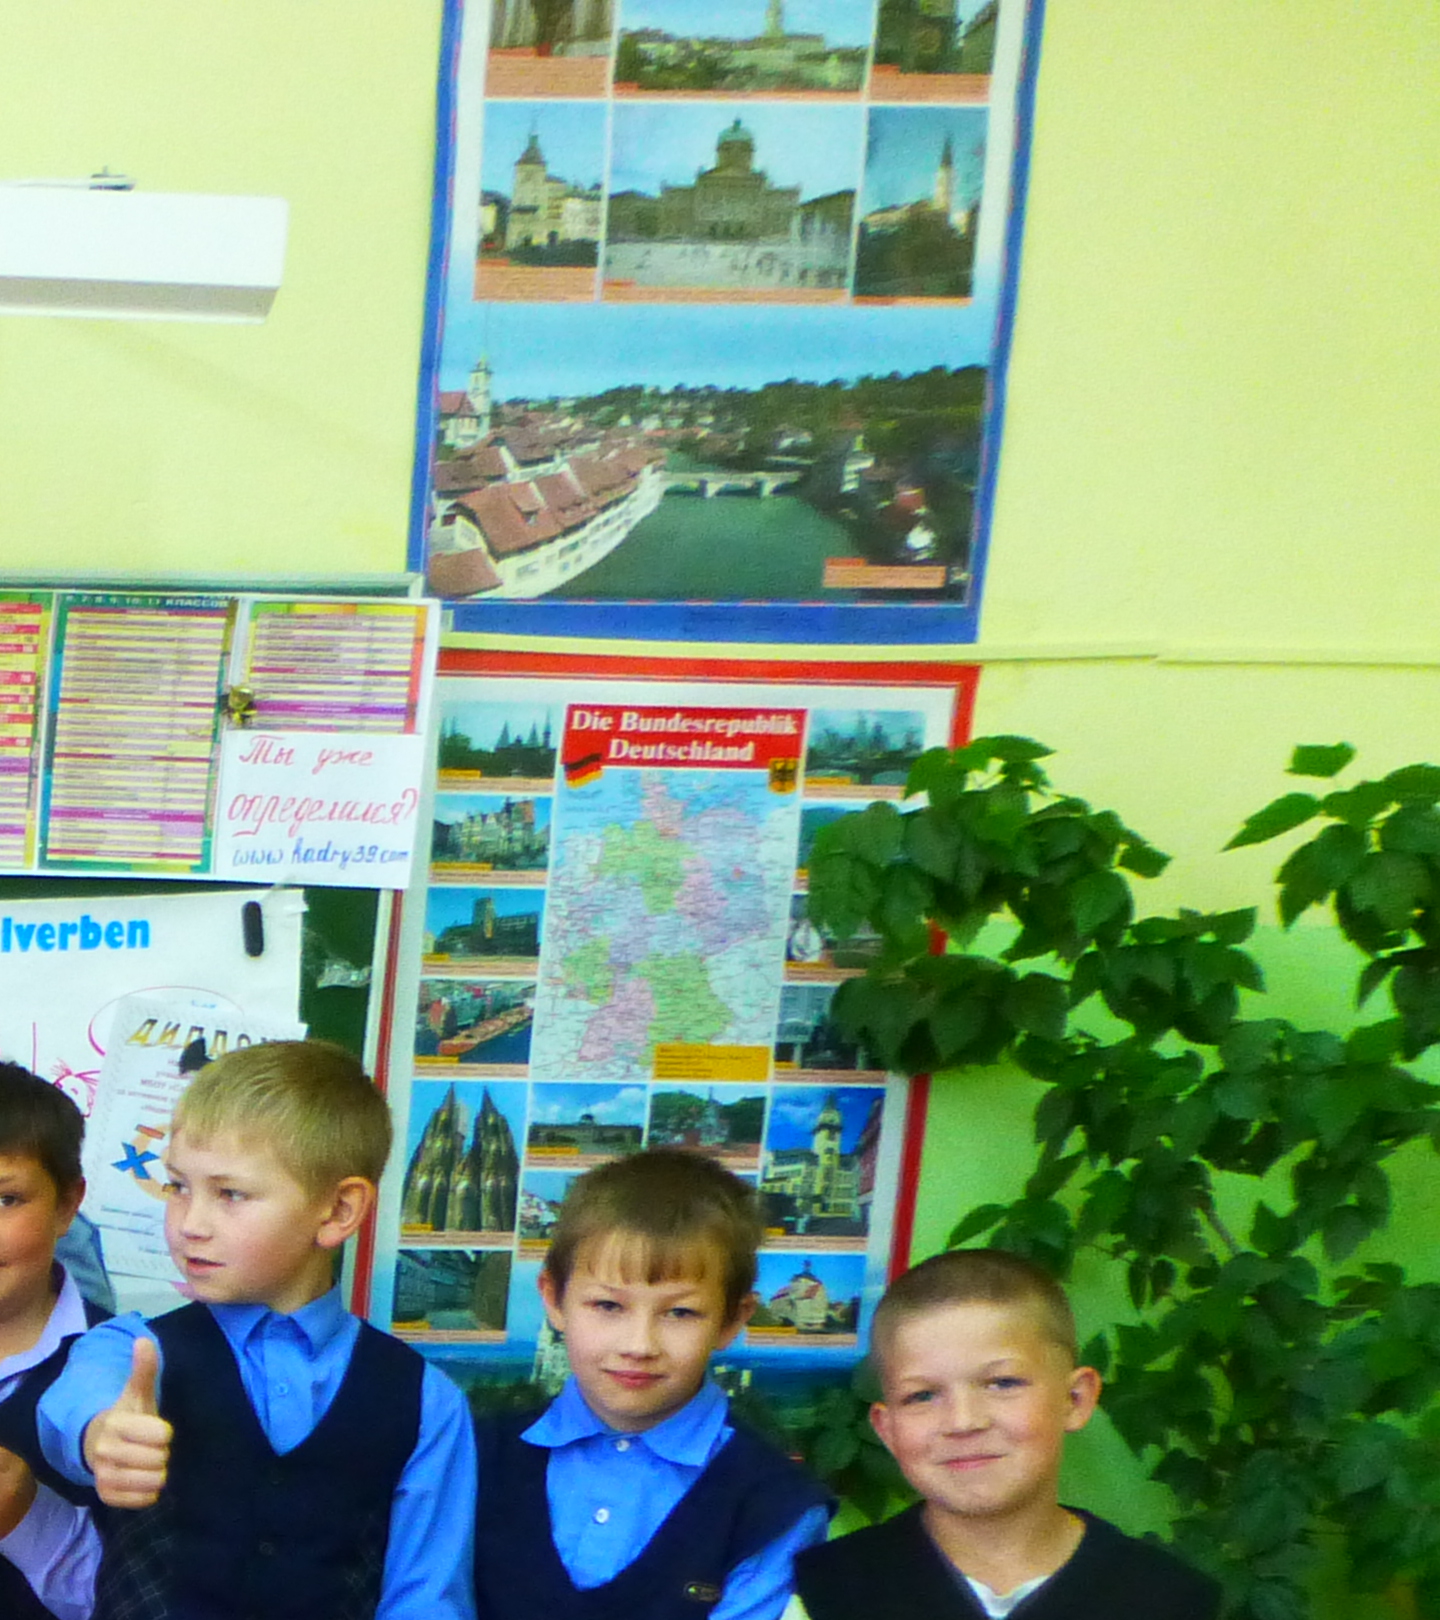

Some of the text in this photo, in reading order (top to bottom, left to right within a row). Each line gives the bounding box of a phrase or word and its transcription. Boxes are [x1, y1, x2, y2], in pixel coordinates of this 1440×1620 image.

[571, 709, 798, 738] Die Bundesrepublik
[238, 734, 375, 775] Ты уже
[607, 738, 756, 762] Deutschland
[125, 1018, 272, 1057] ДИПЛО
